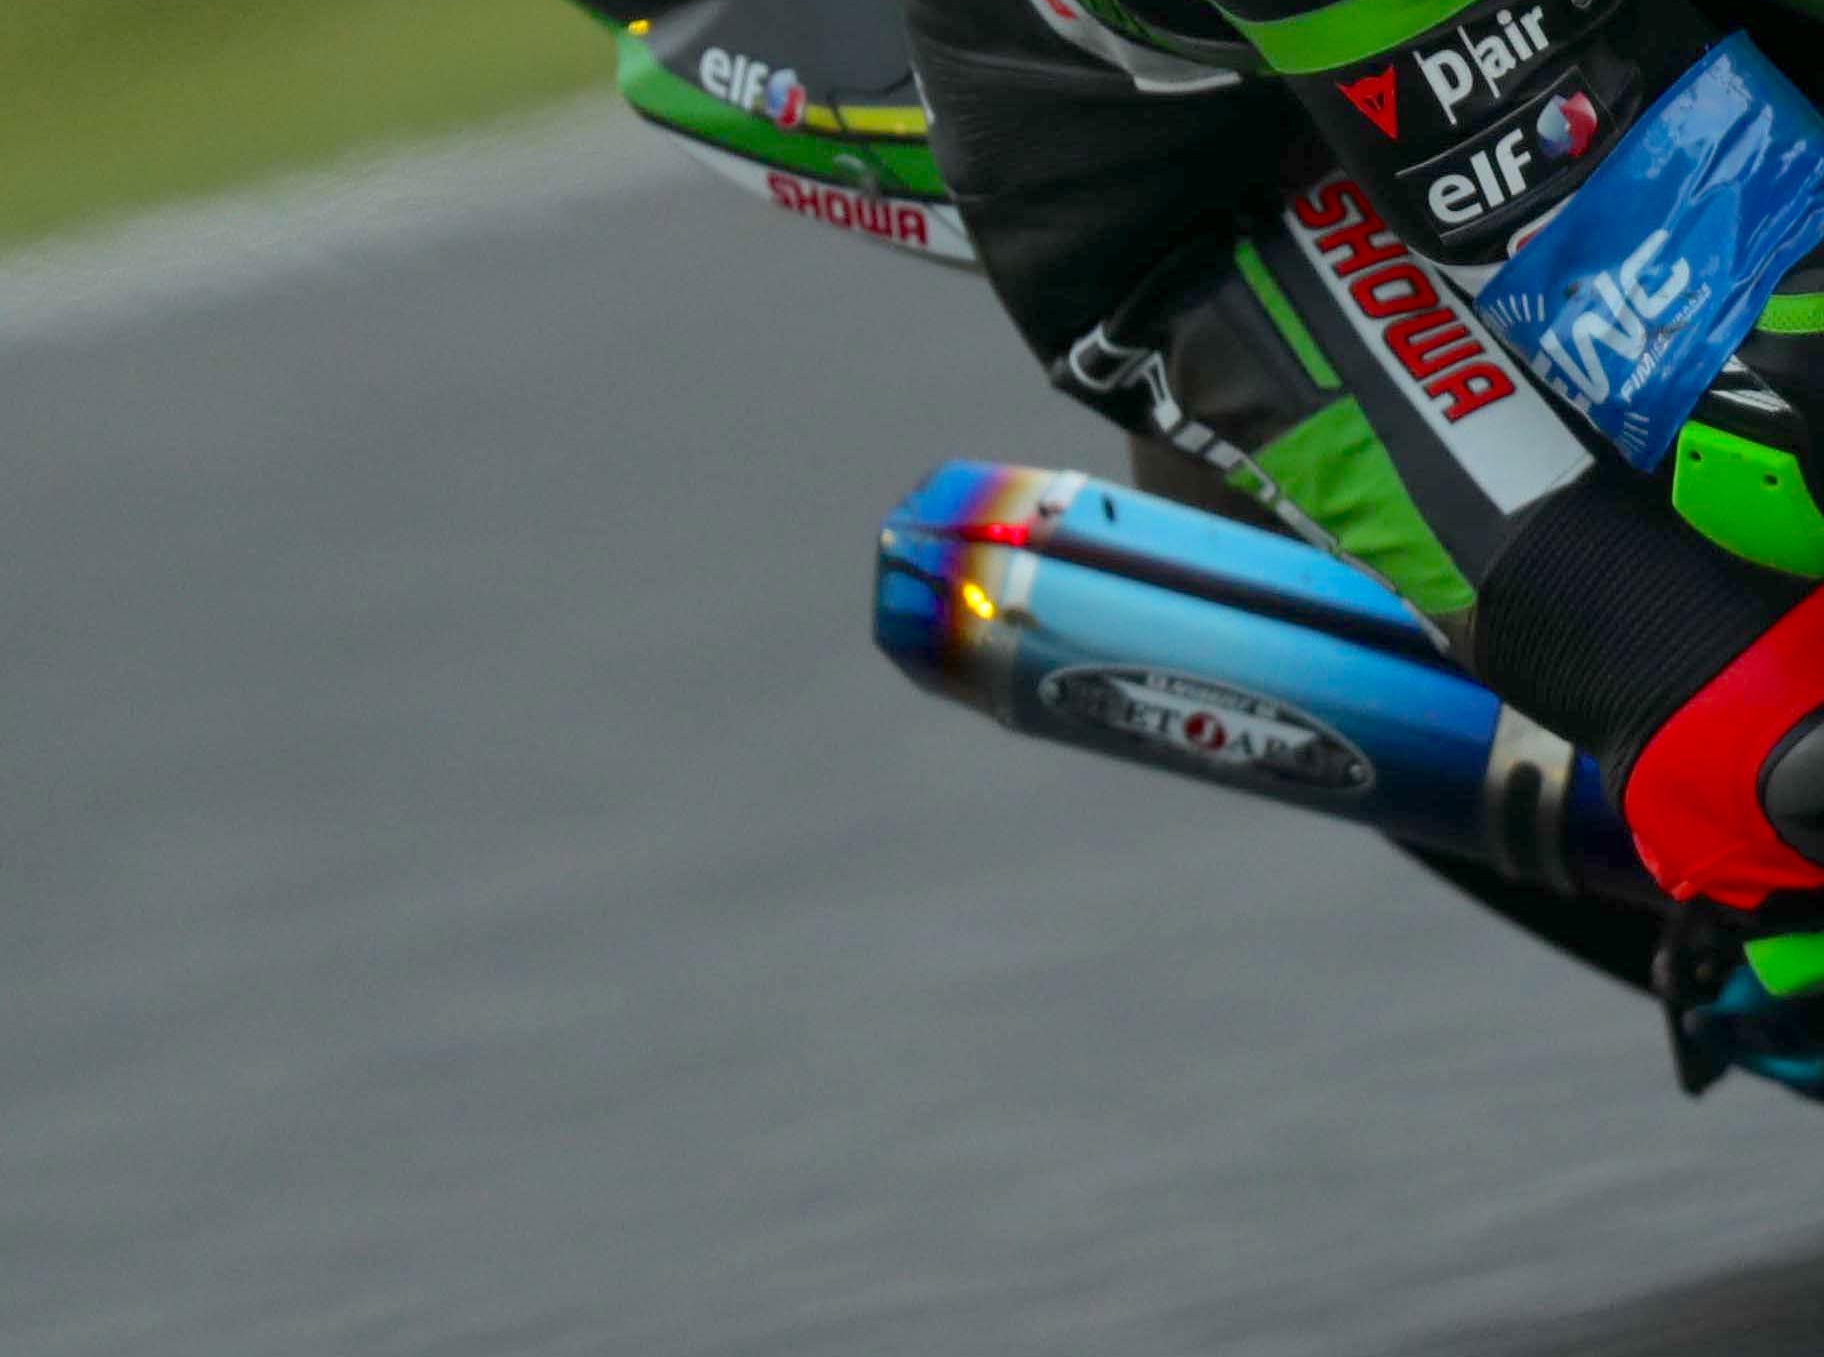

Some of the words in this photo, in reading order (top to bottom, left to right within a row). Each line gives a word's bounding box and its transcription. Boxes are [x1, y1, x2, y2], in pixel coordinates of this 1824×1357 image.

[700, 48, 769, 111] elf
[768, 172, 929, 248] SHOWA
[1428, 128, 1532, 223] elf
[1295, 180, 1517, 424] SHOWA
